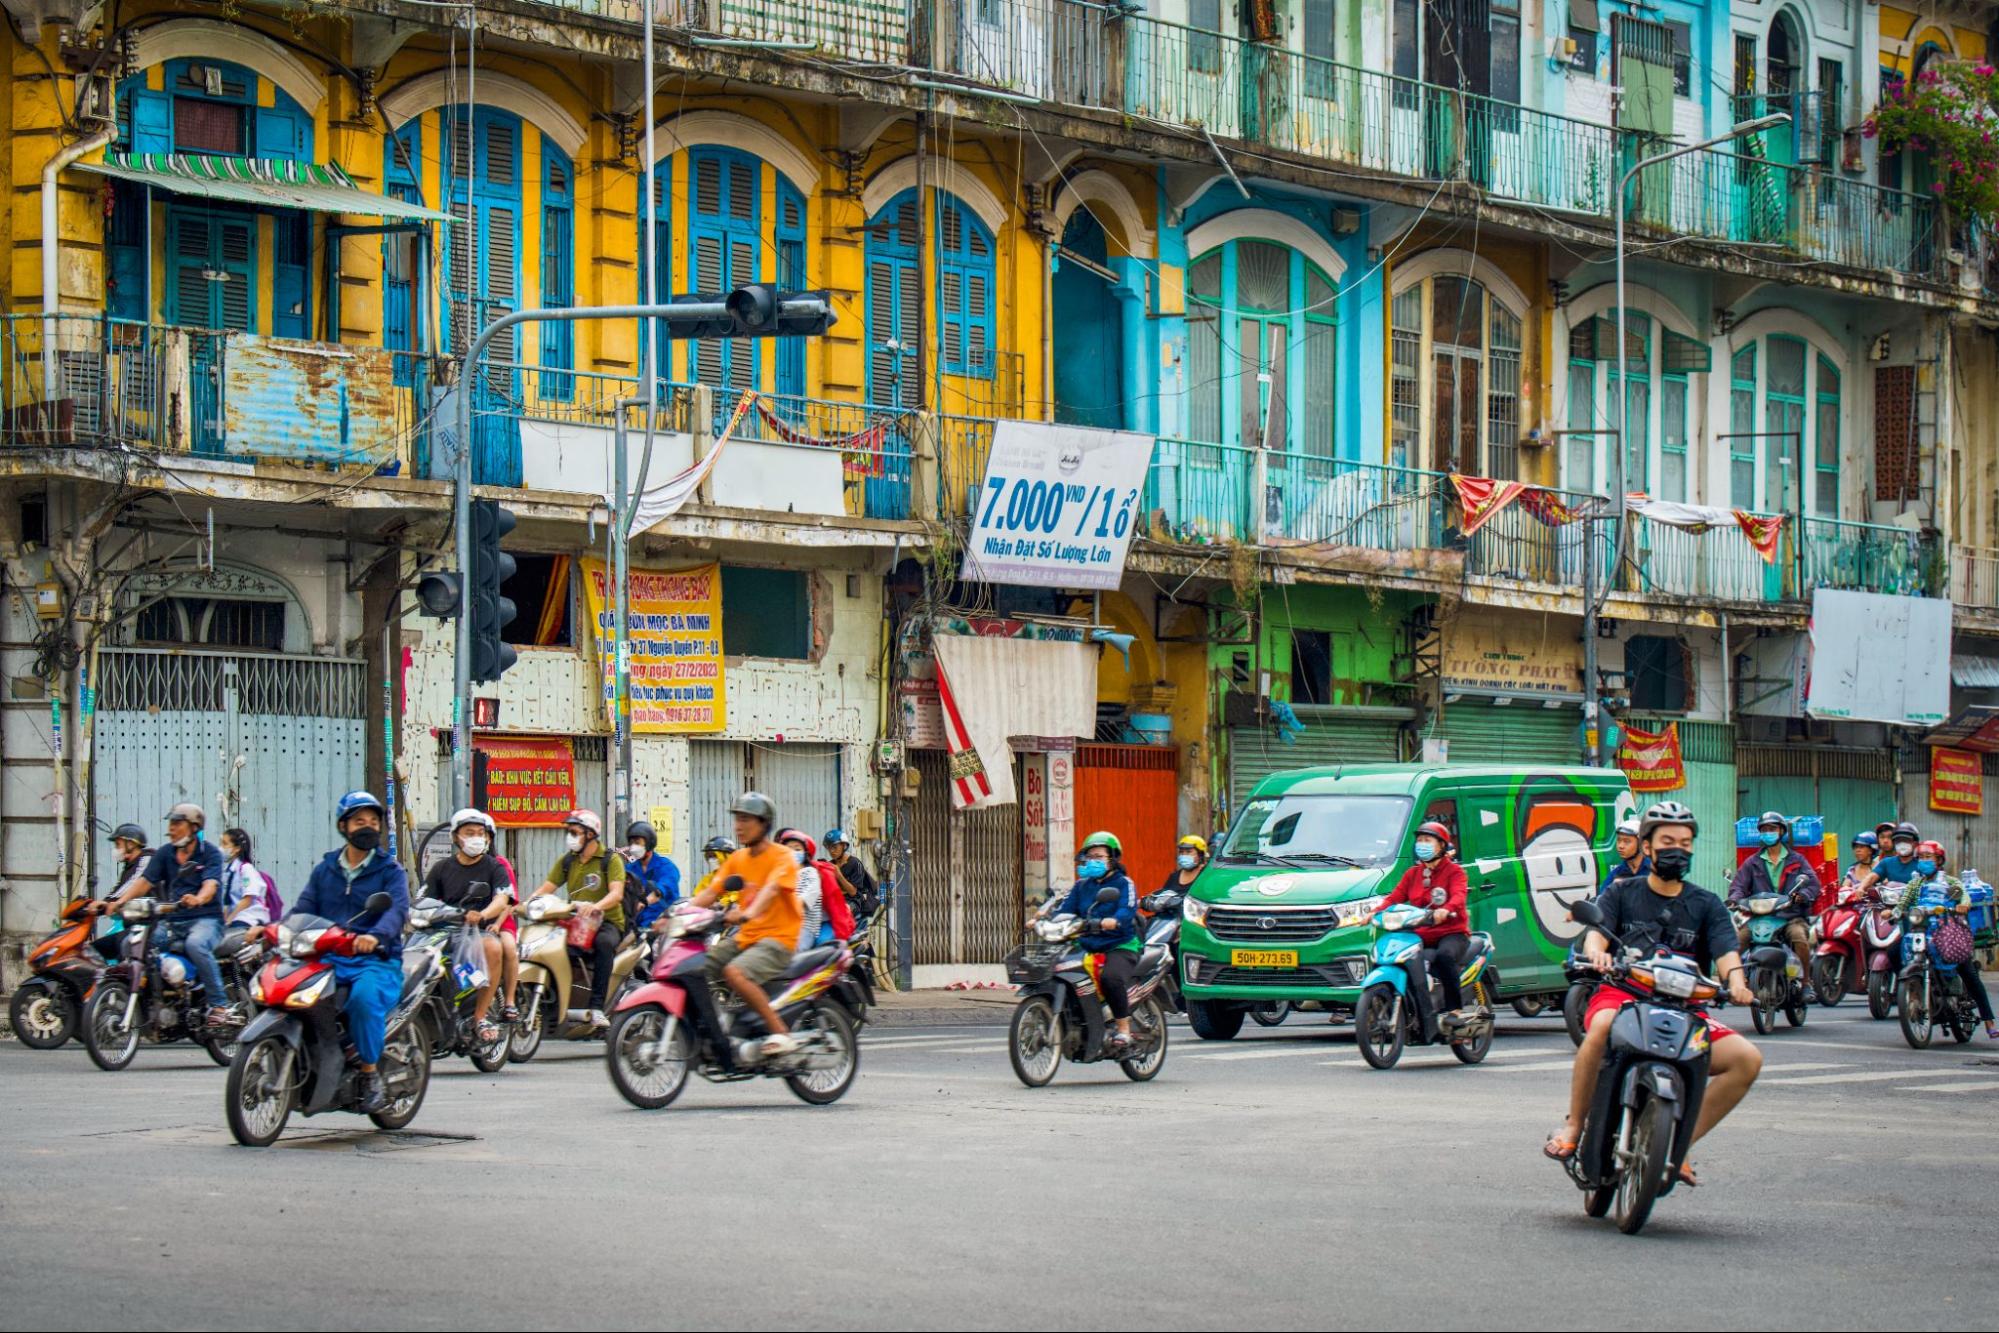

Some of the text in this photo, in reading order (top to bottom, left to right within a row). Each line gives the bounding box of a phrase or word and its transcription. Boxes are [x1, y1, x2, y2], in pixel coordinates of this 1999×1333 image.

[984, 537, 1112, 564] Nhận Đặt Số Lượng Lớn
[647, 615, 668, 634] MỌC
[687, 614, 710, 631] MINH
[638, 640, 646, 655] 37
[649, 662, 672, 679] ngày
[675, 663, 718, 678] 27/2/2023
[1028, 768, 1042, 795] Bò
[1026, 798, 1044, 827] Sốt
[1237, 953, 1292, 965] 50H-273.69
